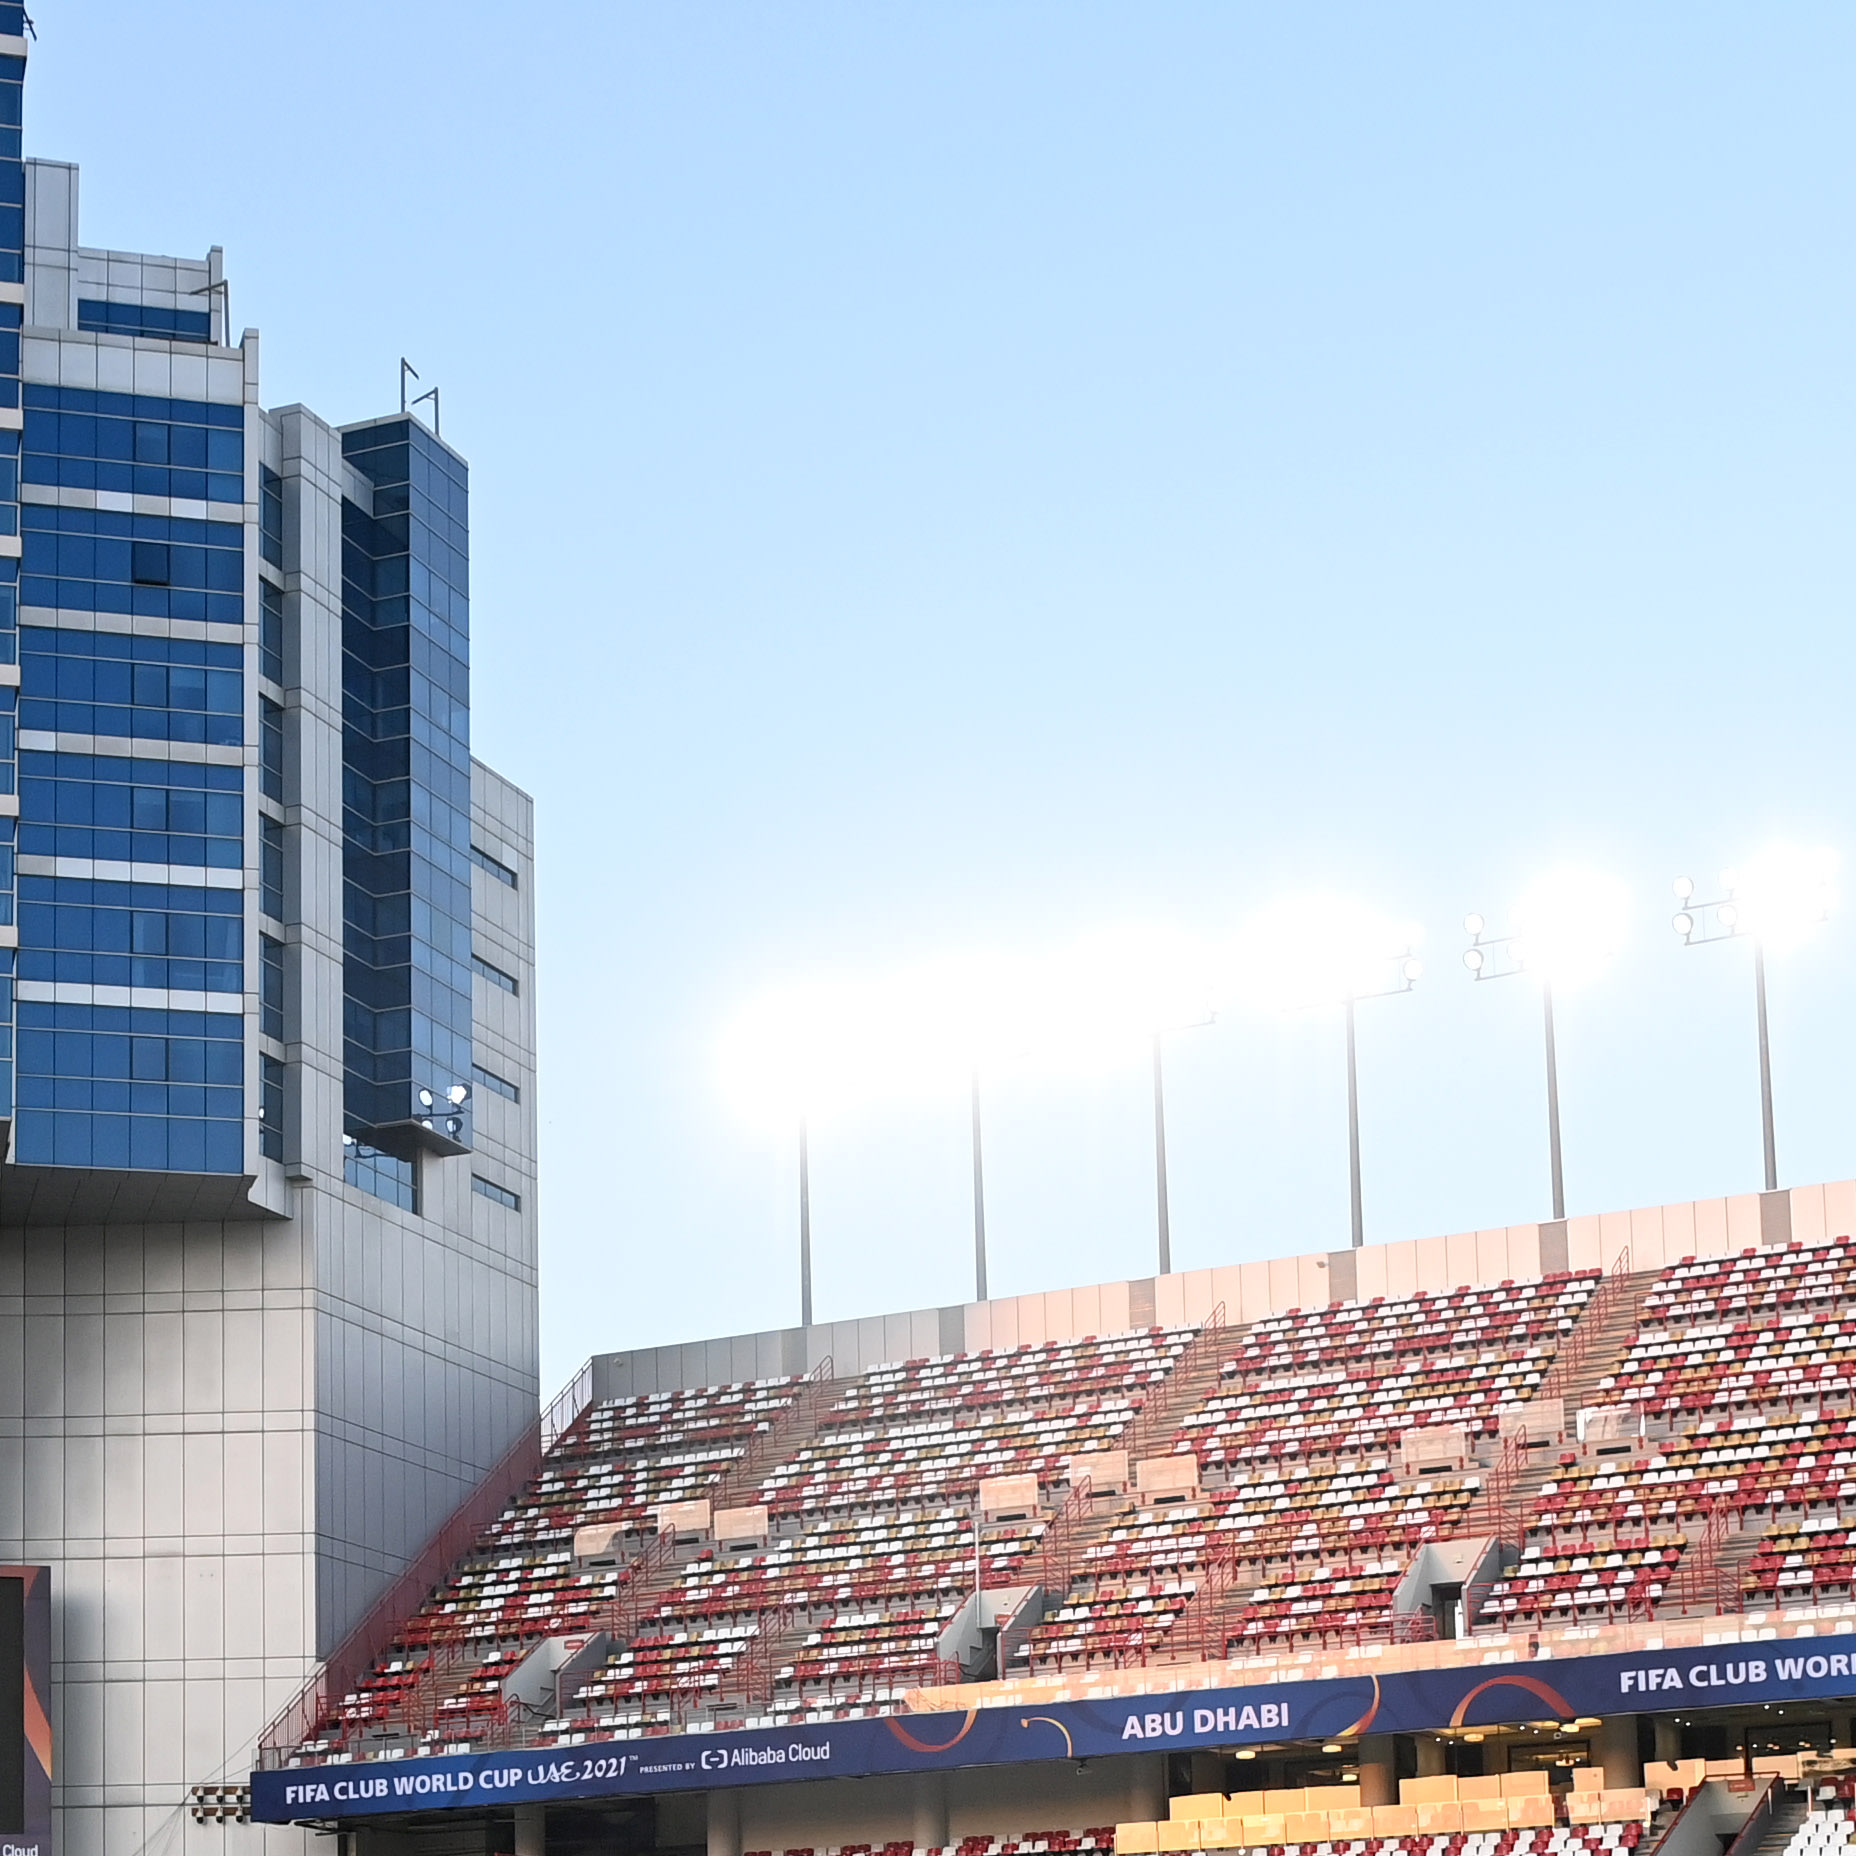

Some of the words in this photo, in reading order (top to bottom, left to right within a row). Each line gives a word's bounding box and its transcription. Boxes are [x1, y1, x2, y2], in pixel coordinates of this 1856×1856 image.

[1619, 1668, 1684, 1693] FIFA
[1688, 1660, 1767, 1687] CLUB
[1122, 1708, 1184, 1741] ABU
[1192, 1701, 1290, 1734] DHABI
[285, 1784, 330, 1804] FIFA
[333, 1779, 389, 1800] CLUB
[393, 1771, 474, 1795] WORLD
[478, 1768, 523, 1789] CUP
[639, 1764, 682, 1774] PRESENTED
[685, 1762, 696, 1771] BY
[731, 1746, 786, 1767] Alibaba
[788, 1741, 830, 1762] Cloud
